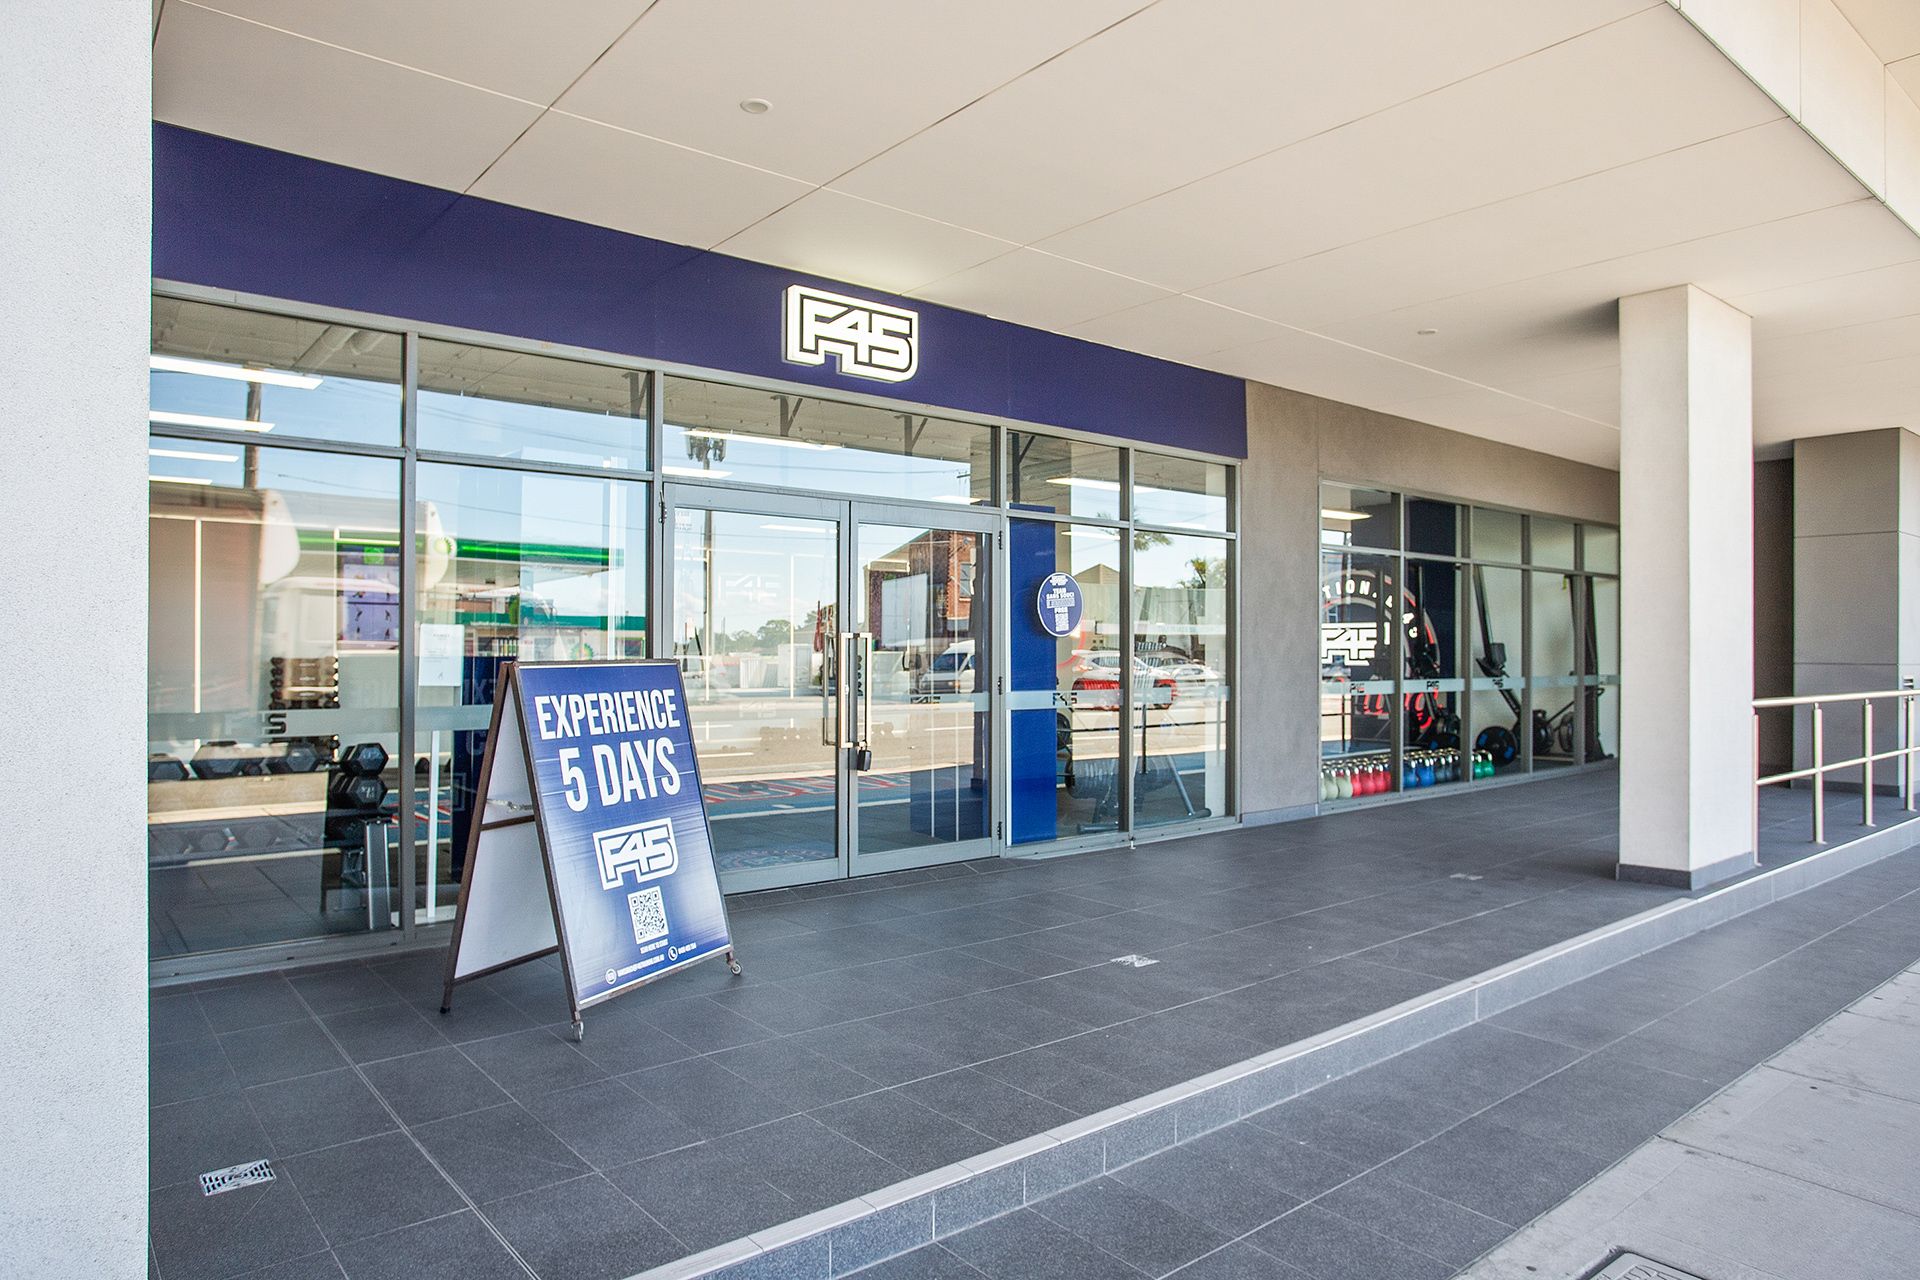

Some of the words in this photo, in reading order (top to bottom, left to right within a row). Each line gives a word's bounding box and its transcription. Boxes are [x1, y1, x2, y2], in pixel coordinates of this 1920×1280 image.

[783, 285, 919, 382] F45
[534, 689, 681, 740] EXPERIENCE
[558, 747, 589, 812] 5
[592, 737, 681, 807] DAYS
[592, 817, 680, 891] F45
